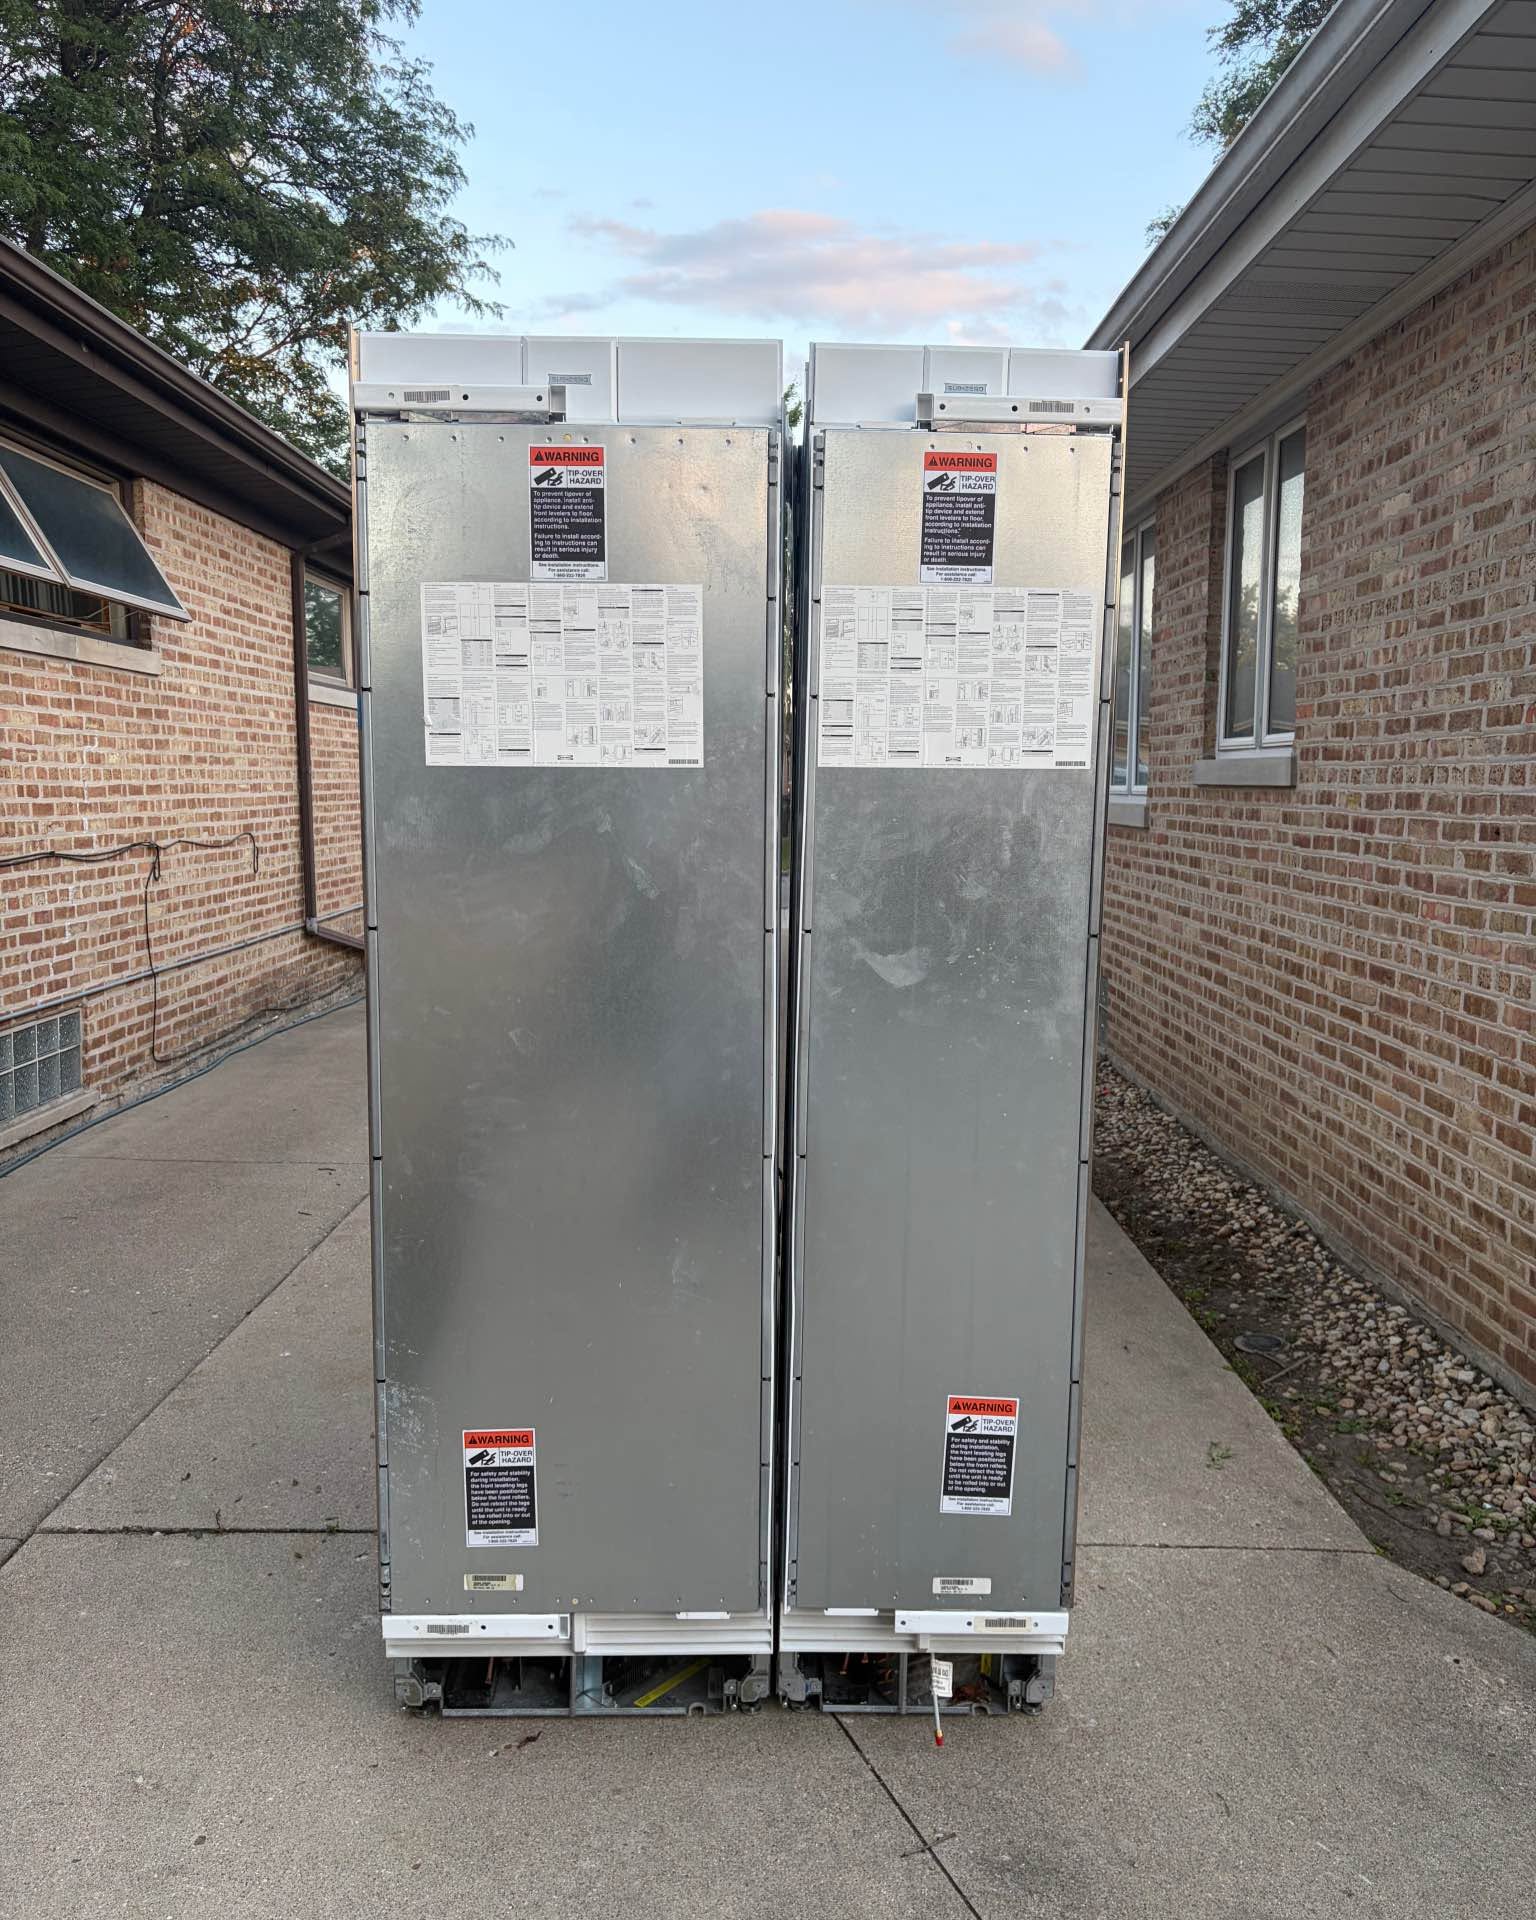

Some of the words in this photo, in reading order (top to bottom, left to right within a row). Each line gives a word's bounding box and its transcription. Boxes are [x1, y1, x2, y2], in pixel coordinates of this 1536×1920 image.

[544, 452, 599, 462] WARNING
[939, 457, 992, 468] WARNING
[962, 1403, 1012, 1413] WARNING
[478, 1435, 529, 1444] WARNING
